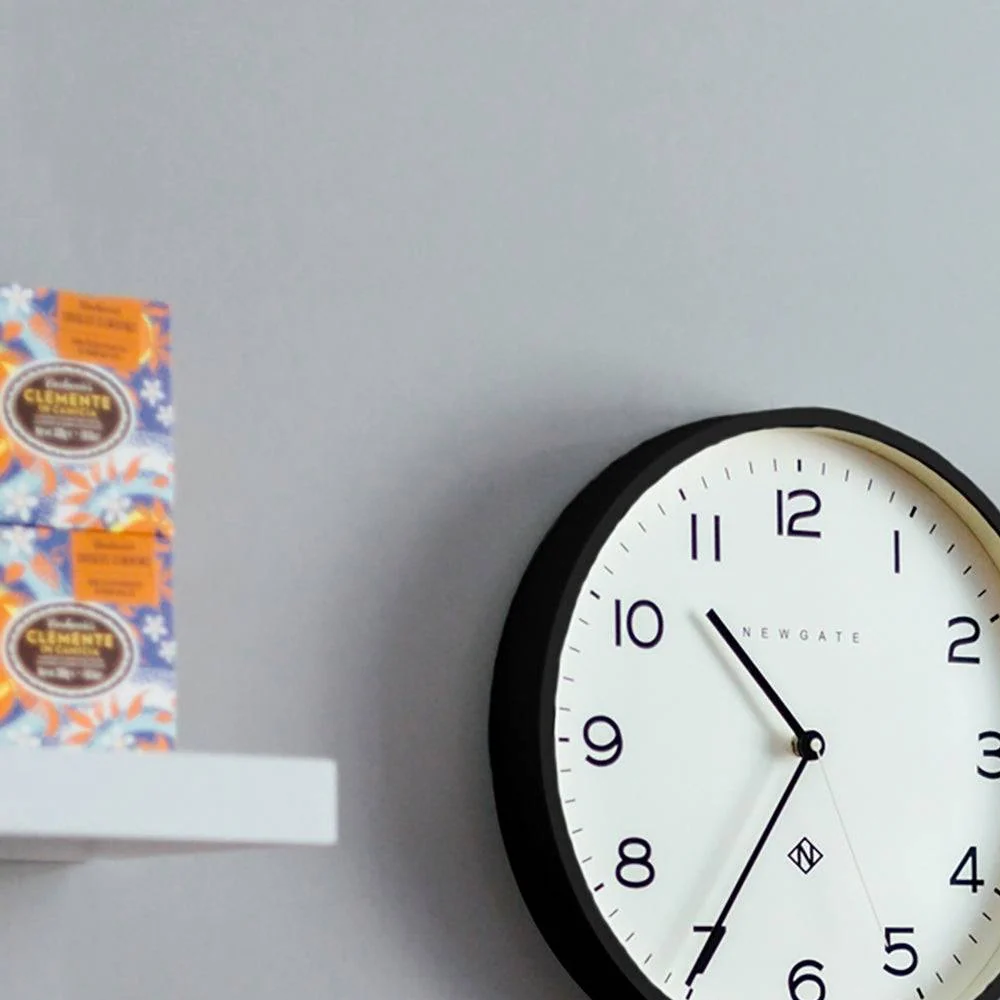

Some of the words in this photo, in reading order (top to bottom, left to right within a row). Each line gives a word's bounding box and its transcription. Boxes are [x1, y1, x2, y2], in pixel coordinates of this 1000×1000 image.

[691, 513, 721, 562] 11
[777, 489, 821, 538] 12
[893, 530, 900, 573] 1
[614, 599, 664, 649] 10
[742, 626, 860, 644] NEWGATE
[947, 616, 981, 664] 2
[582, 715, 623, 766] 9
[615, 838, 655, 888] 8
[949, 846, 985, 893] 4
[883, 927, 918, 977] 5
